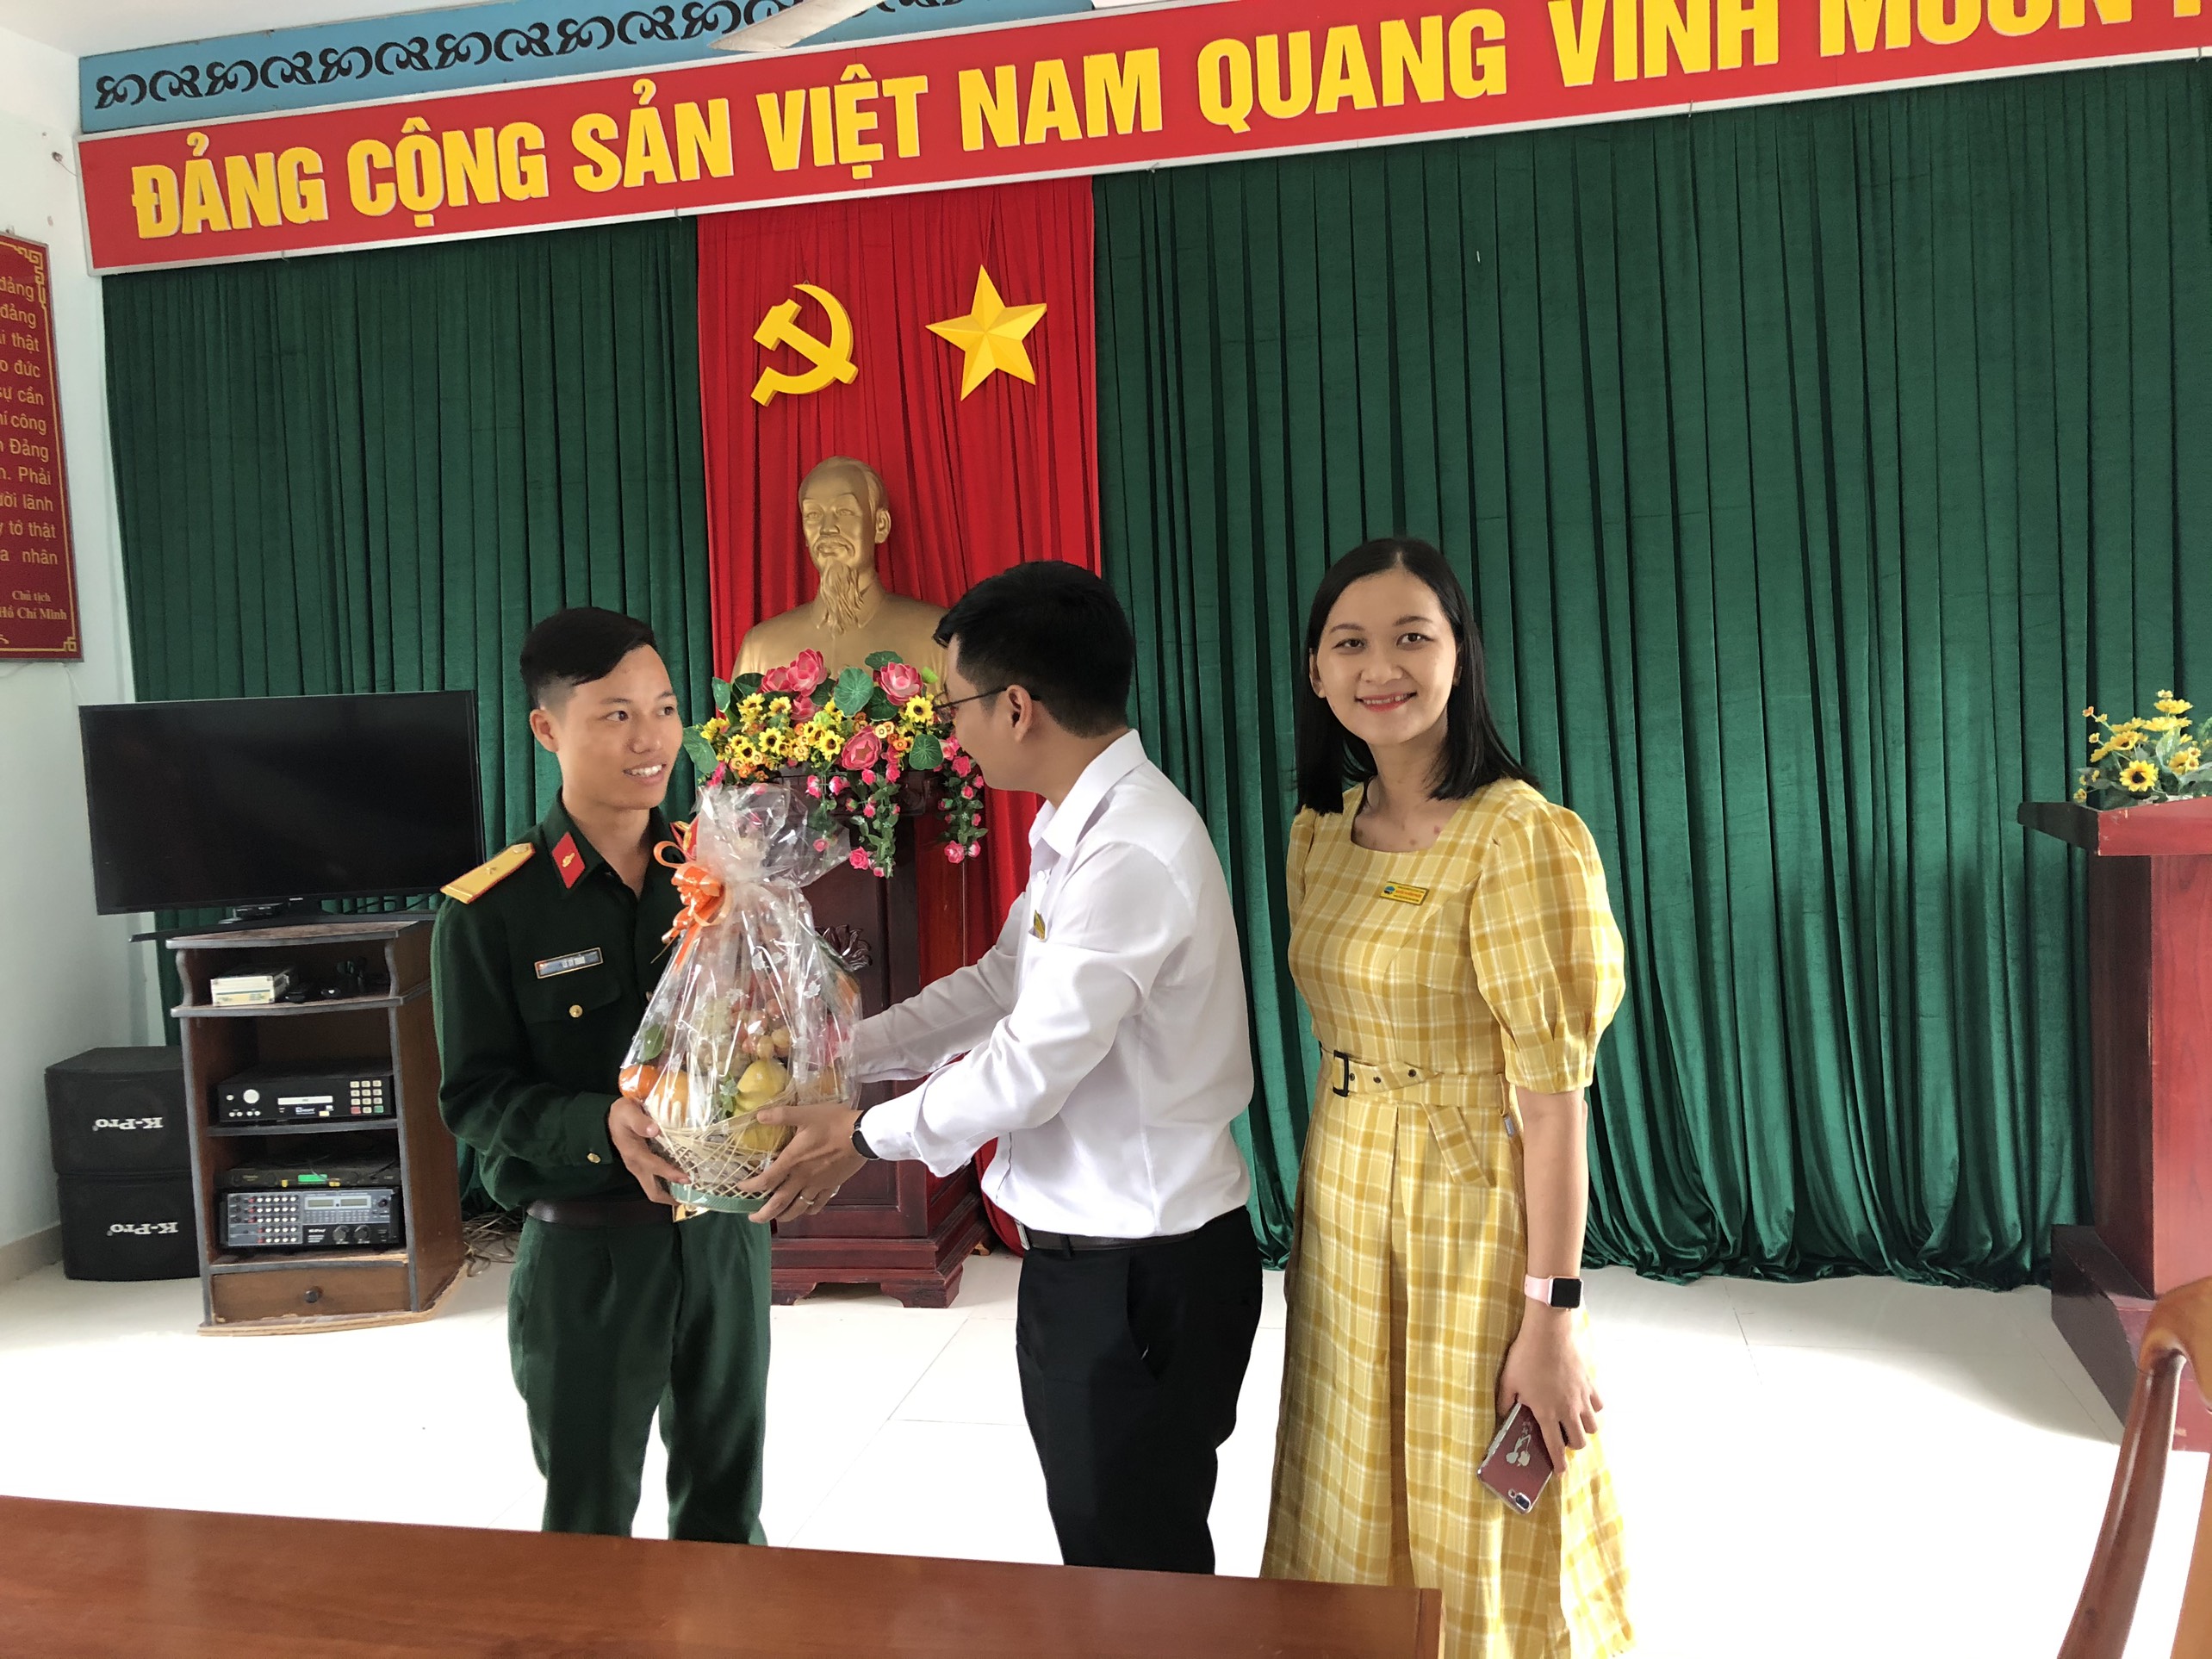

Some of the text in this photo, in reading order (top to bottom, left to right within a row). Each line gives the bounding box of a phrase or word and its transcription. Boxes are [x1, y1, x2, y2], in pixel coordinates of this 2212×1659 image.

[132, 132, 329, 239] ĐẢNG
[346, 117, 549, 227] CỘNG
[571, 78, 734, 192] SẢN
[755, 64, 929, 180] VIỆT
[958, 48, 1163, 152] NAM
[1196, 9, 1507, 134] QUANG
[1547, 0, 1780, 87] VINH
[0, 303, 36, 329] đảng
[11, 332, 40, 354] thật
[14, 359, 40, 378] đức
[17, 386, 44, 406] cần
[10, 413, 47, 436] công
[9, 438, 49, 463] Đảng
[18, 466, 52, 485] Phải
[22, 494, 54, 512] lãnh
[28, 522, 57, 542] thật
[22, 548, 59, 565] nhân
[39, 607, 67, 620] Minh
[94, 1116, 165, 1131] K-Pro
[109, 1221, 179, 1236] K-Pro
